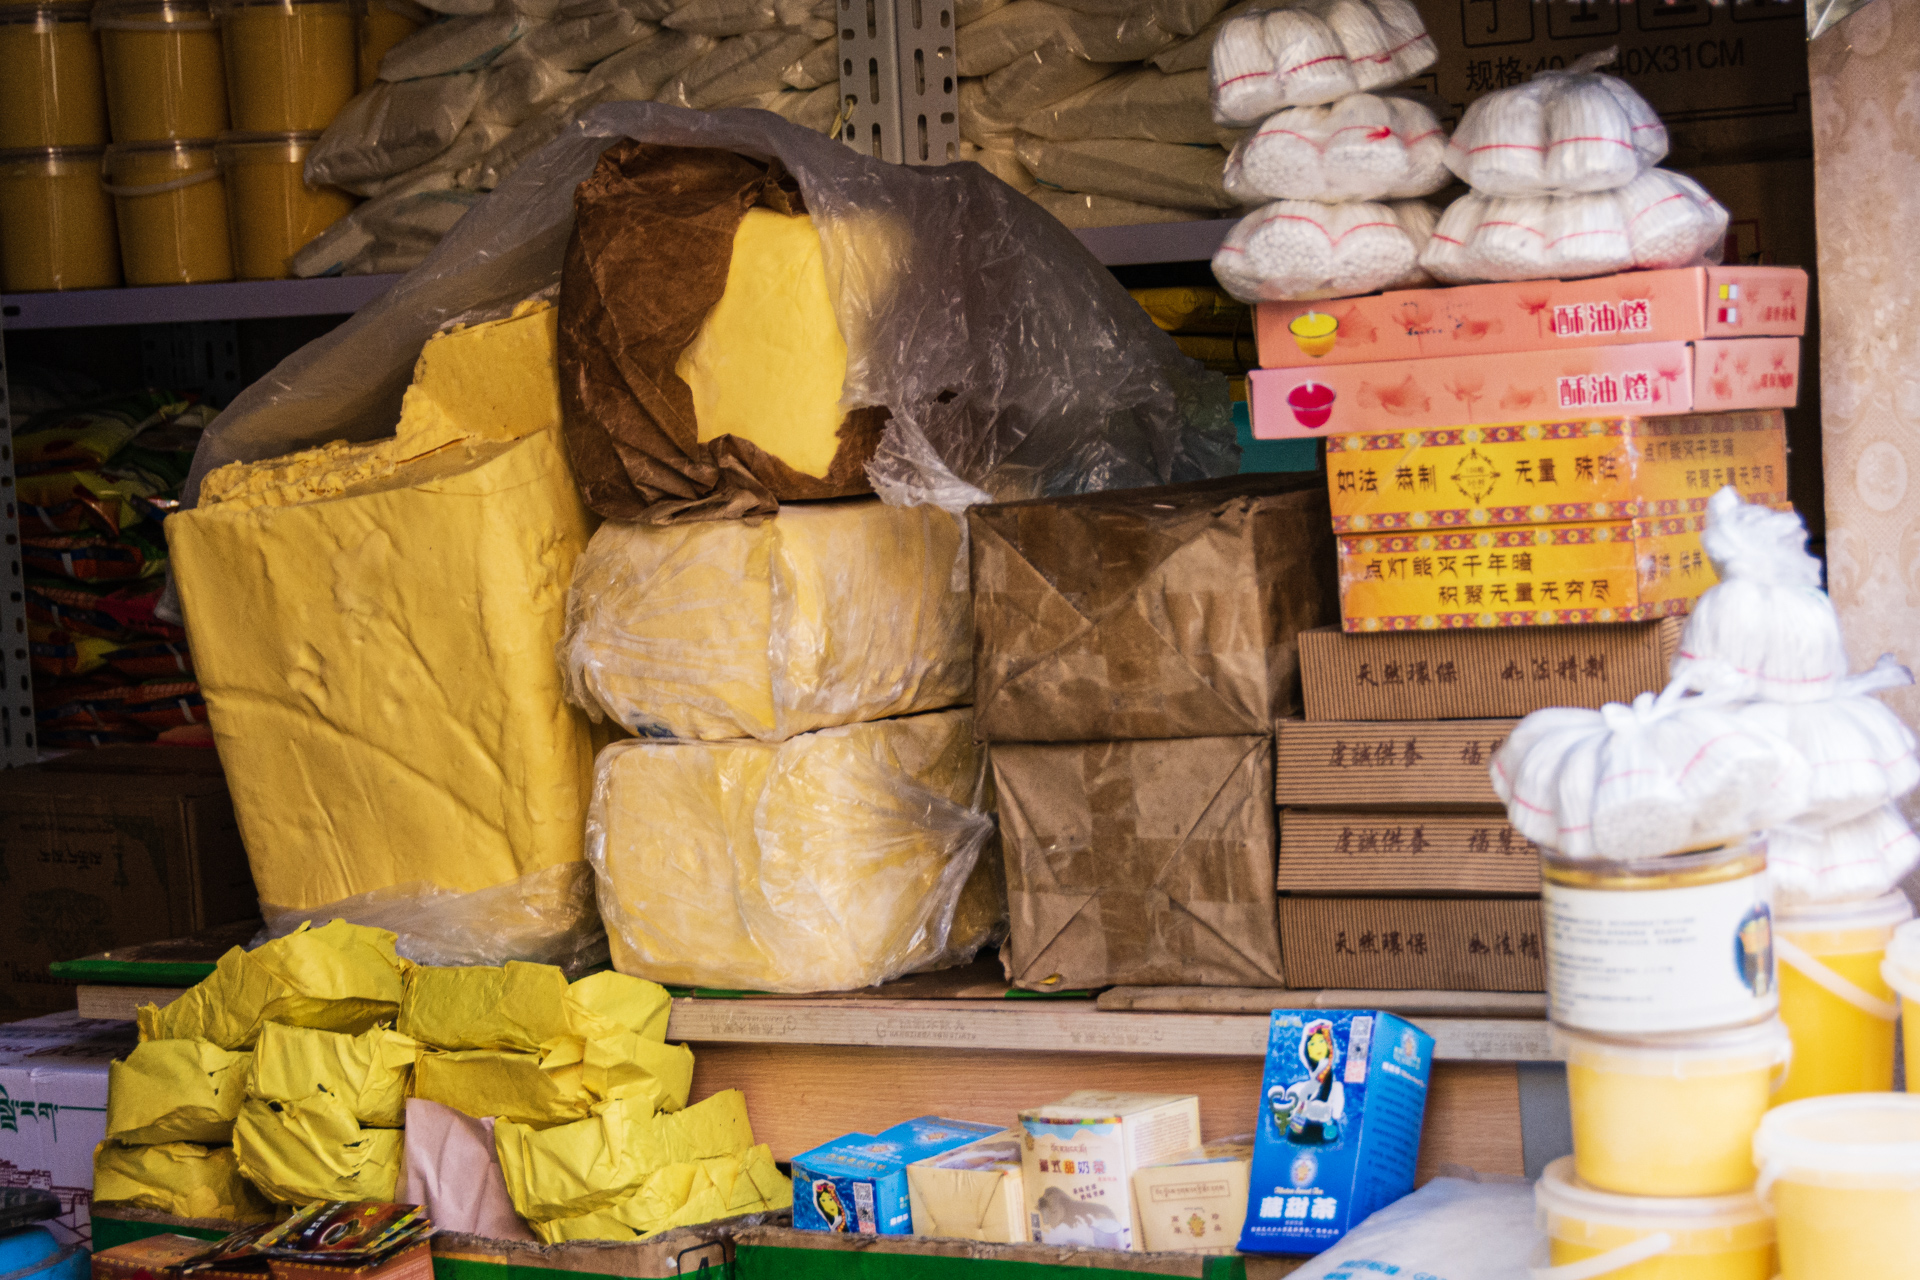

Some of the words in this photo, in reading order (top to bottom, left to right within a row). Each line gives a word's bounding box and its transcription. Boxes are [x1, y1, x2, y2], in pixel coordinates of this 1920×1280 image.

[1336, 467, 1378, 495] 如法
[1515, 457, 1557, 487] 无量
[1574, 454, 1619, 482] 殊胜
[1364, 550, 1534, 581] 点灯能灭千年暗
